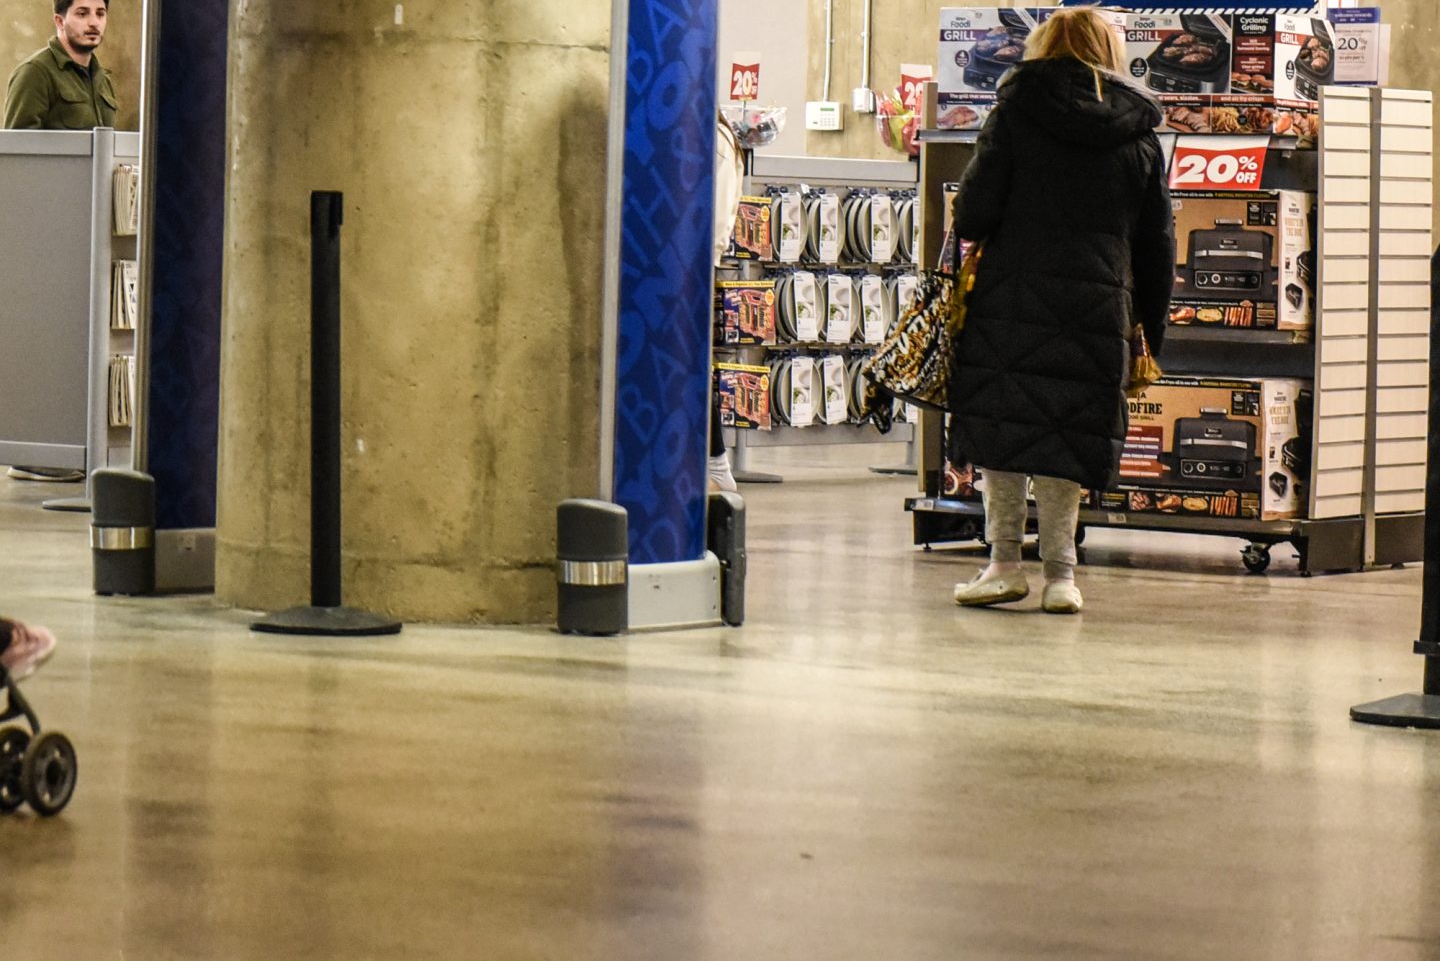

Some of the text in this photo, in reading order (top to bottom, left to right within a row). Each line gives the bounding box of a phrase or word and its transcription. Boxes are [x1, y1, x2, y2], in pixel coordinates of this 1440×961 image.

[950, 20, 971, 28] Foodi
[1134, 20, 1156, 29] Foodi
[1240, 16, 1269, 25] Cyclonic
[1241, 24, 1267, 33] Grilling
[943, 30, 977, 41] GRILL
[1127, 31, 1162, 41] GRILL
[1280, 32, 1299, 45] GRILL
[1172, 154, 1258, 184] 20%
[1235, 171, 1257, 184] OFF
